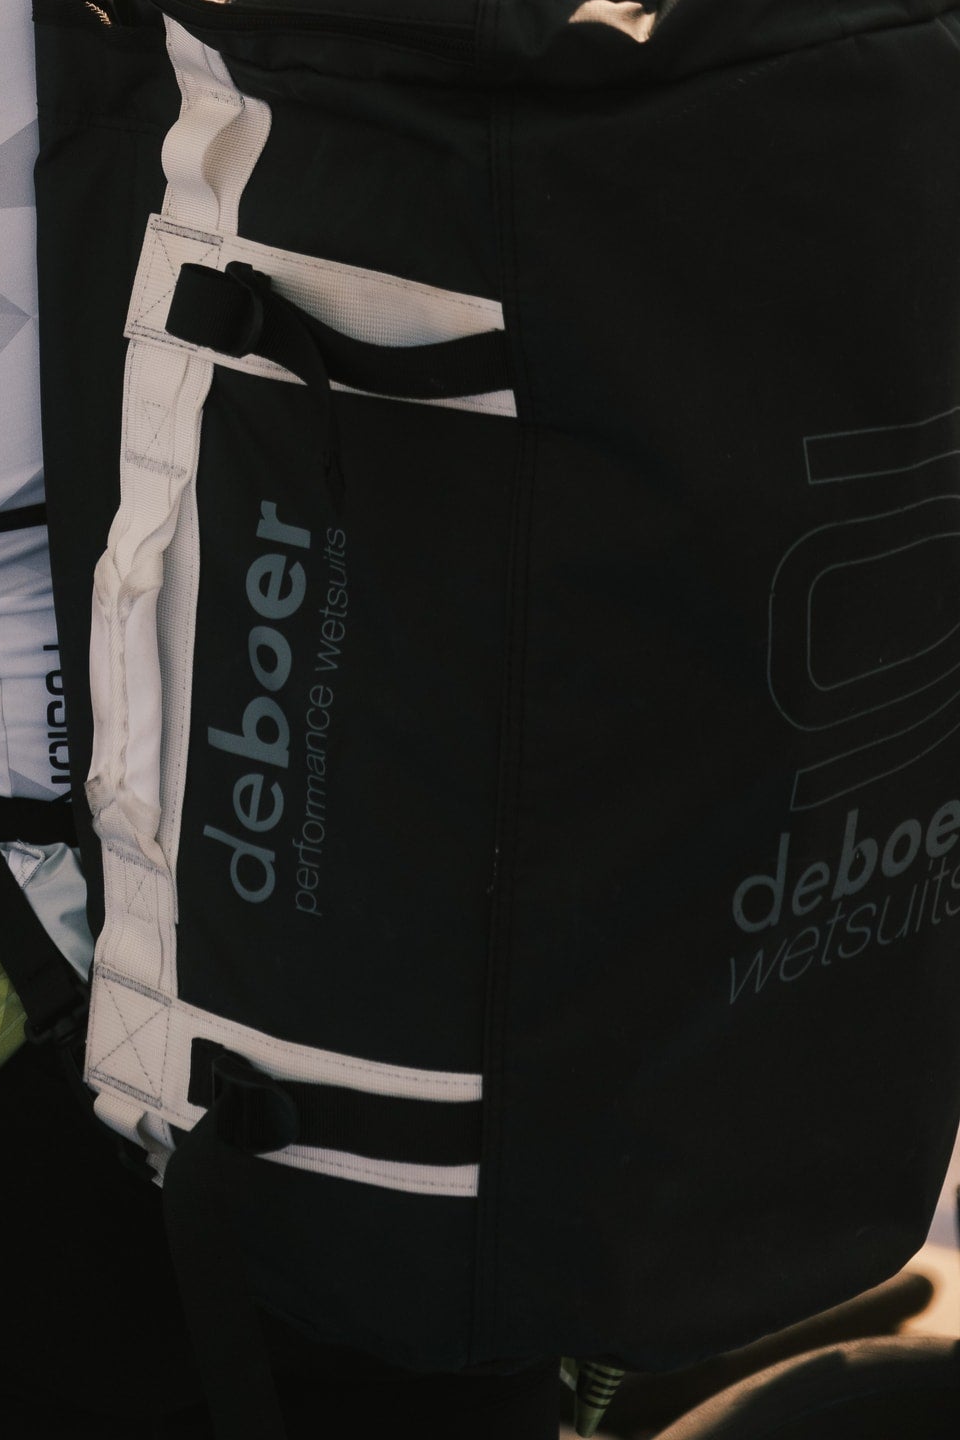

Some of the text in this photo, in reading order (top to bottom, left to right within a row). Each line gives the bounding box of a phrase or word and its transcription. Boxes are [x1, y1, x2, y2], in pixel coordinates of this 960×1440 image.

[202, 499, 311, 904] deboer
[292, 526, 348, 916] performance wetsuits
